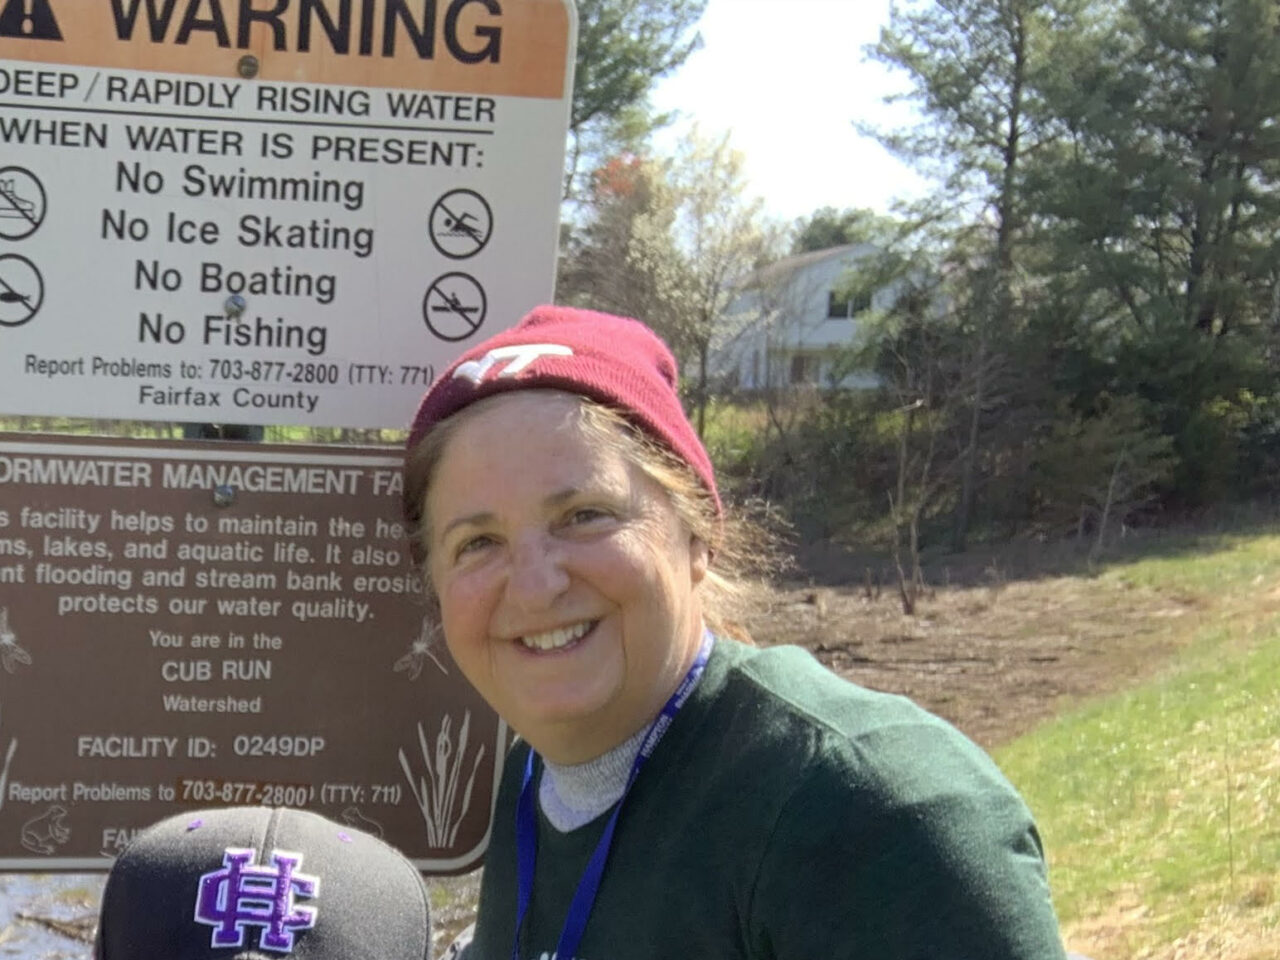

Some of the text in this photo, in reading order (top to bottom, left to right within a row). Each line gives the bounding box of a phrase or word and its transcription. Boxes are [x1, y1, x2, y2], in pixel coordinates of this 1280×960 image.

[111, 0, 503, 64] WARNING
[256, 86, 370, 117] RISING
[386, 93, 496, 123] WATER
[126, 125, 243, 157] WATER
[261, 133, 293, 159] IS
[311, 135, 484, 168] PRESENT:
[116, 162, 365, 210] No Swimming
[101, 210, 374, 257] No Ice Skating
[134, 261, 336, 303] No Boating
[138, 314, 327, 354] No Fishing
[25, 354, 83, 379] Report
[91, 356, 171, 379] Problems
[180, 361, 203, 379] to:
[209, 359, 339, 385] 703-877-2800
[348, 362, 393, 386] (TTY:
[139, 386, 319, 412] Fairfax County
[162, 463, 360, 496] MANAGEMENT
[21, 507, 100, 534] facility
[110, 510, 174, 534] helps
[185, 514, 212, 533] to
[219, 512, 317, 536] maintain
[328, 517, 366, 538] the
[43, 536, 114, 560] lakes,
[124, 538, 167, 560] and
[177, 540, 264, 566] aquatic
[272, 541, 316, 565] life.
[326, 543, 341, 564] It
[352, 545, 400, 567] also
[36, 564, 131, 590] flooding
[142, 566, 185, 588] and
[195, 569, 277, 591] stream
[286, 568, 342, 591] bank
[58, 593, 375, 622] protects our water quality.
[149, 631, 282, 651] You are in the
[161, 659, 271, 683] CUB RUN
[162, 694, 262, 714] Watershed
[78, 735, 177, 758] FACILITY
[187, 737, 216, 759] ID:
[9, 782, 66, 804] Report
[73, 783, 150, 800] Problems
[158, 784, 175, 800] to
[321, 783, 365, 804] (TTY:
